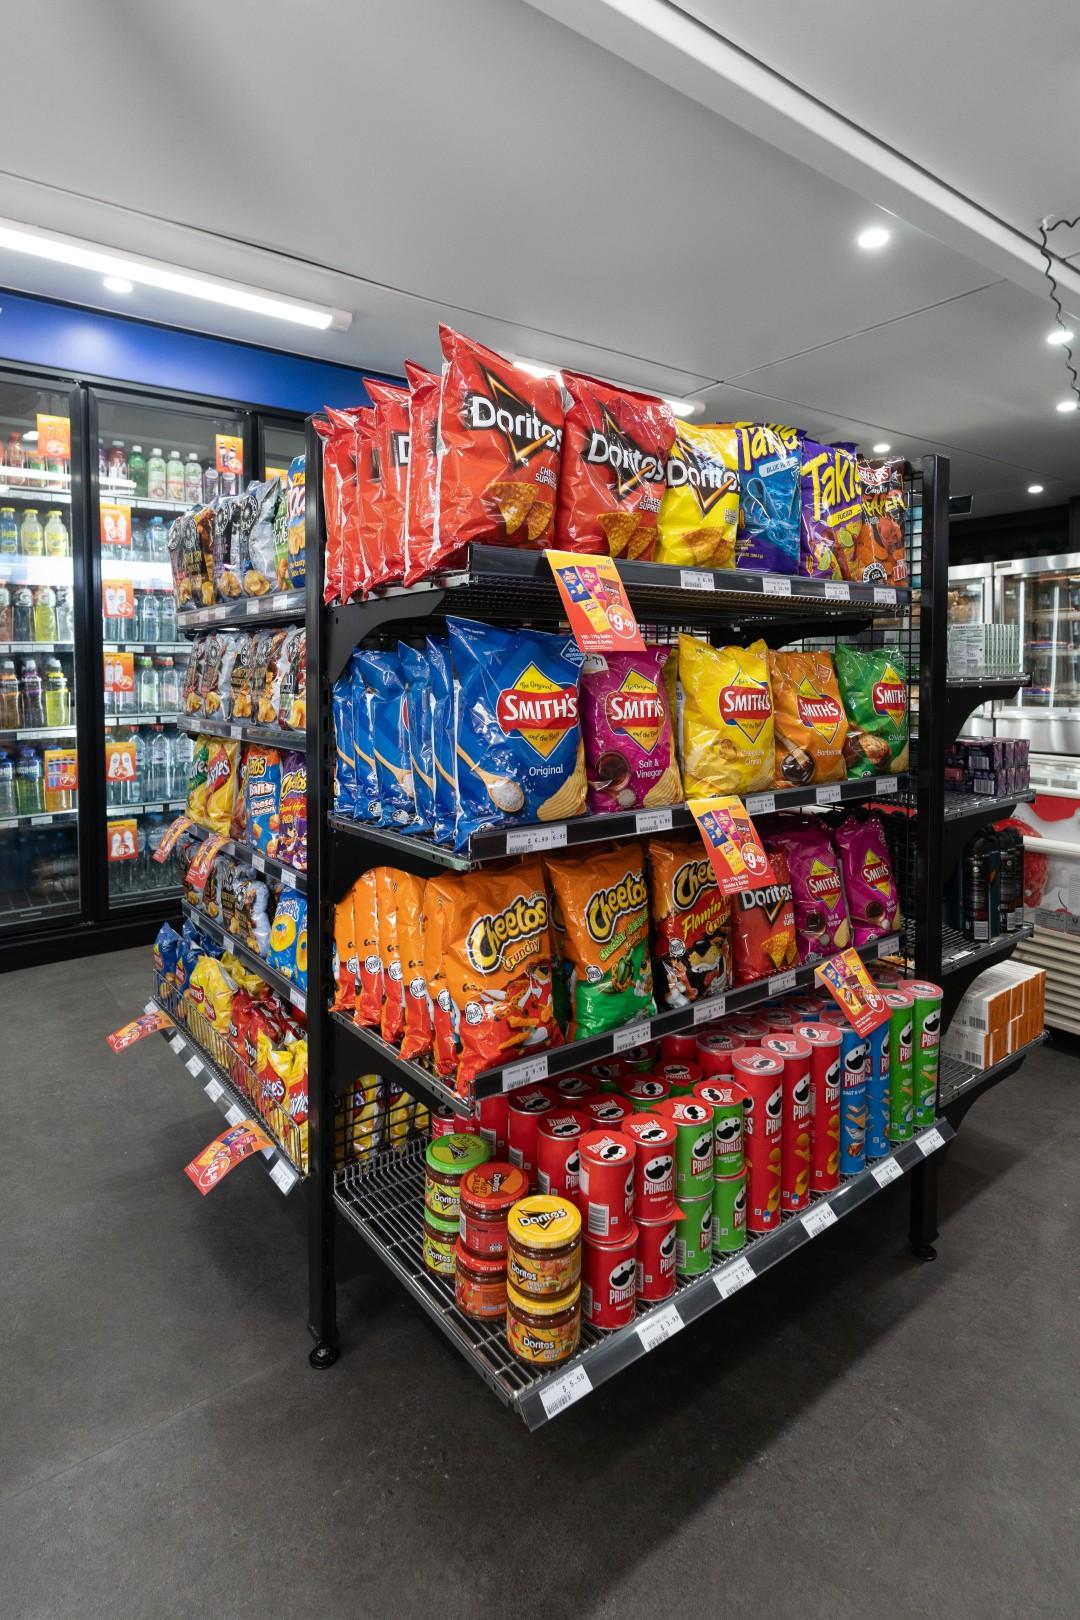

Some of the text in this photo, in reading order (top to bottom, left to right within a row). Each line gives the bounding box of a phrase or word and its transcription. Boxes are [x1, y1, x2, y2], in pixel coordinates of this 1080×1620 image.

[588, 432, 664, 482] Doritos
[766, 463, 779, 474] BLUE
[503, 694, 577, 721] SMITH'S
[723, 689, 771, 713] SMITH'S
[529, 763, 563, 779] Original
[639, 758, 659, 768] Salt &
[636, 768, 663, 780] Vinegar
[673, 859, 718, 910] Chee
[808, 873, 840, 894] SMITH'S
[586, 873, 648, 942] Cheetos
[467, 897, 548, 971] Cheetos
[501, 937, 540, 972] Crunchy
[715, 1140, 742, 1155] PRINGLES
[643, 1177, 673, 1195] PRINGLES
[434, 1192, 460, 1205] Doritos
[519, 1208, 567, 1227] Doritos
[511, 1260, 537, 1281] Doritos
[608, 1287, 636, 1305] PRINGLES
[523, 1336, 554, 1350] Doritos
[569, 1373, 585, 1388] 5.50
